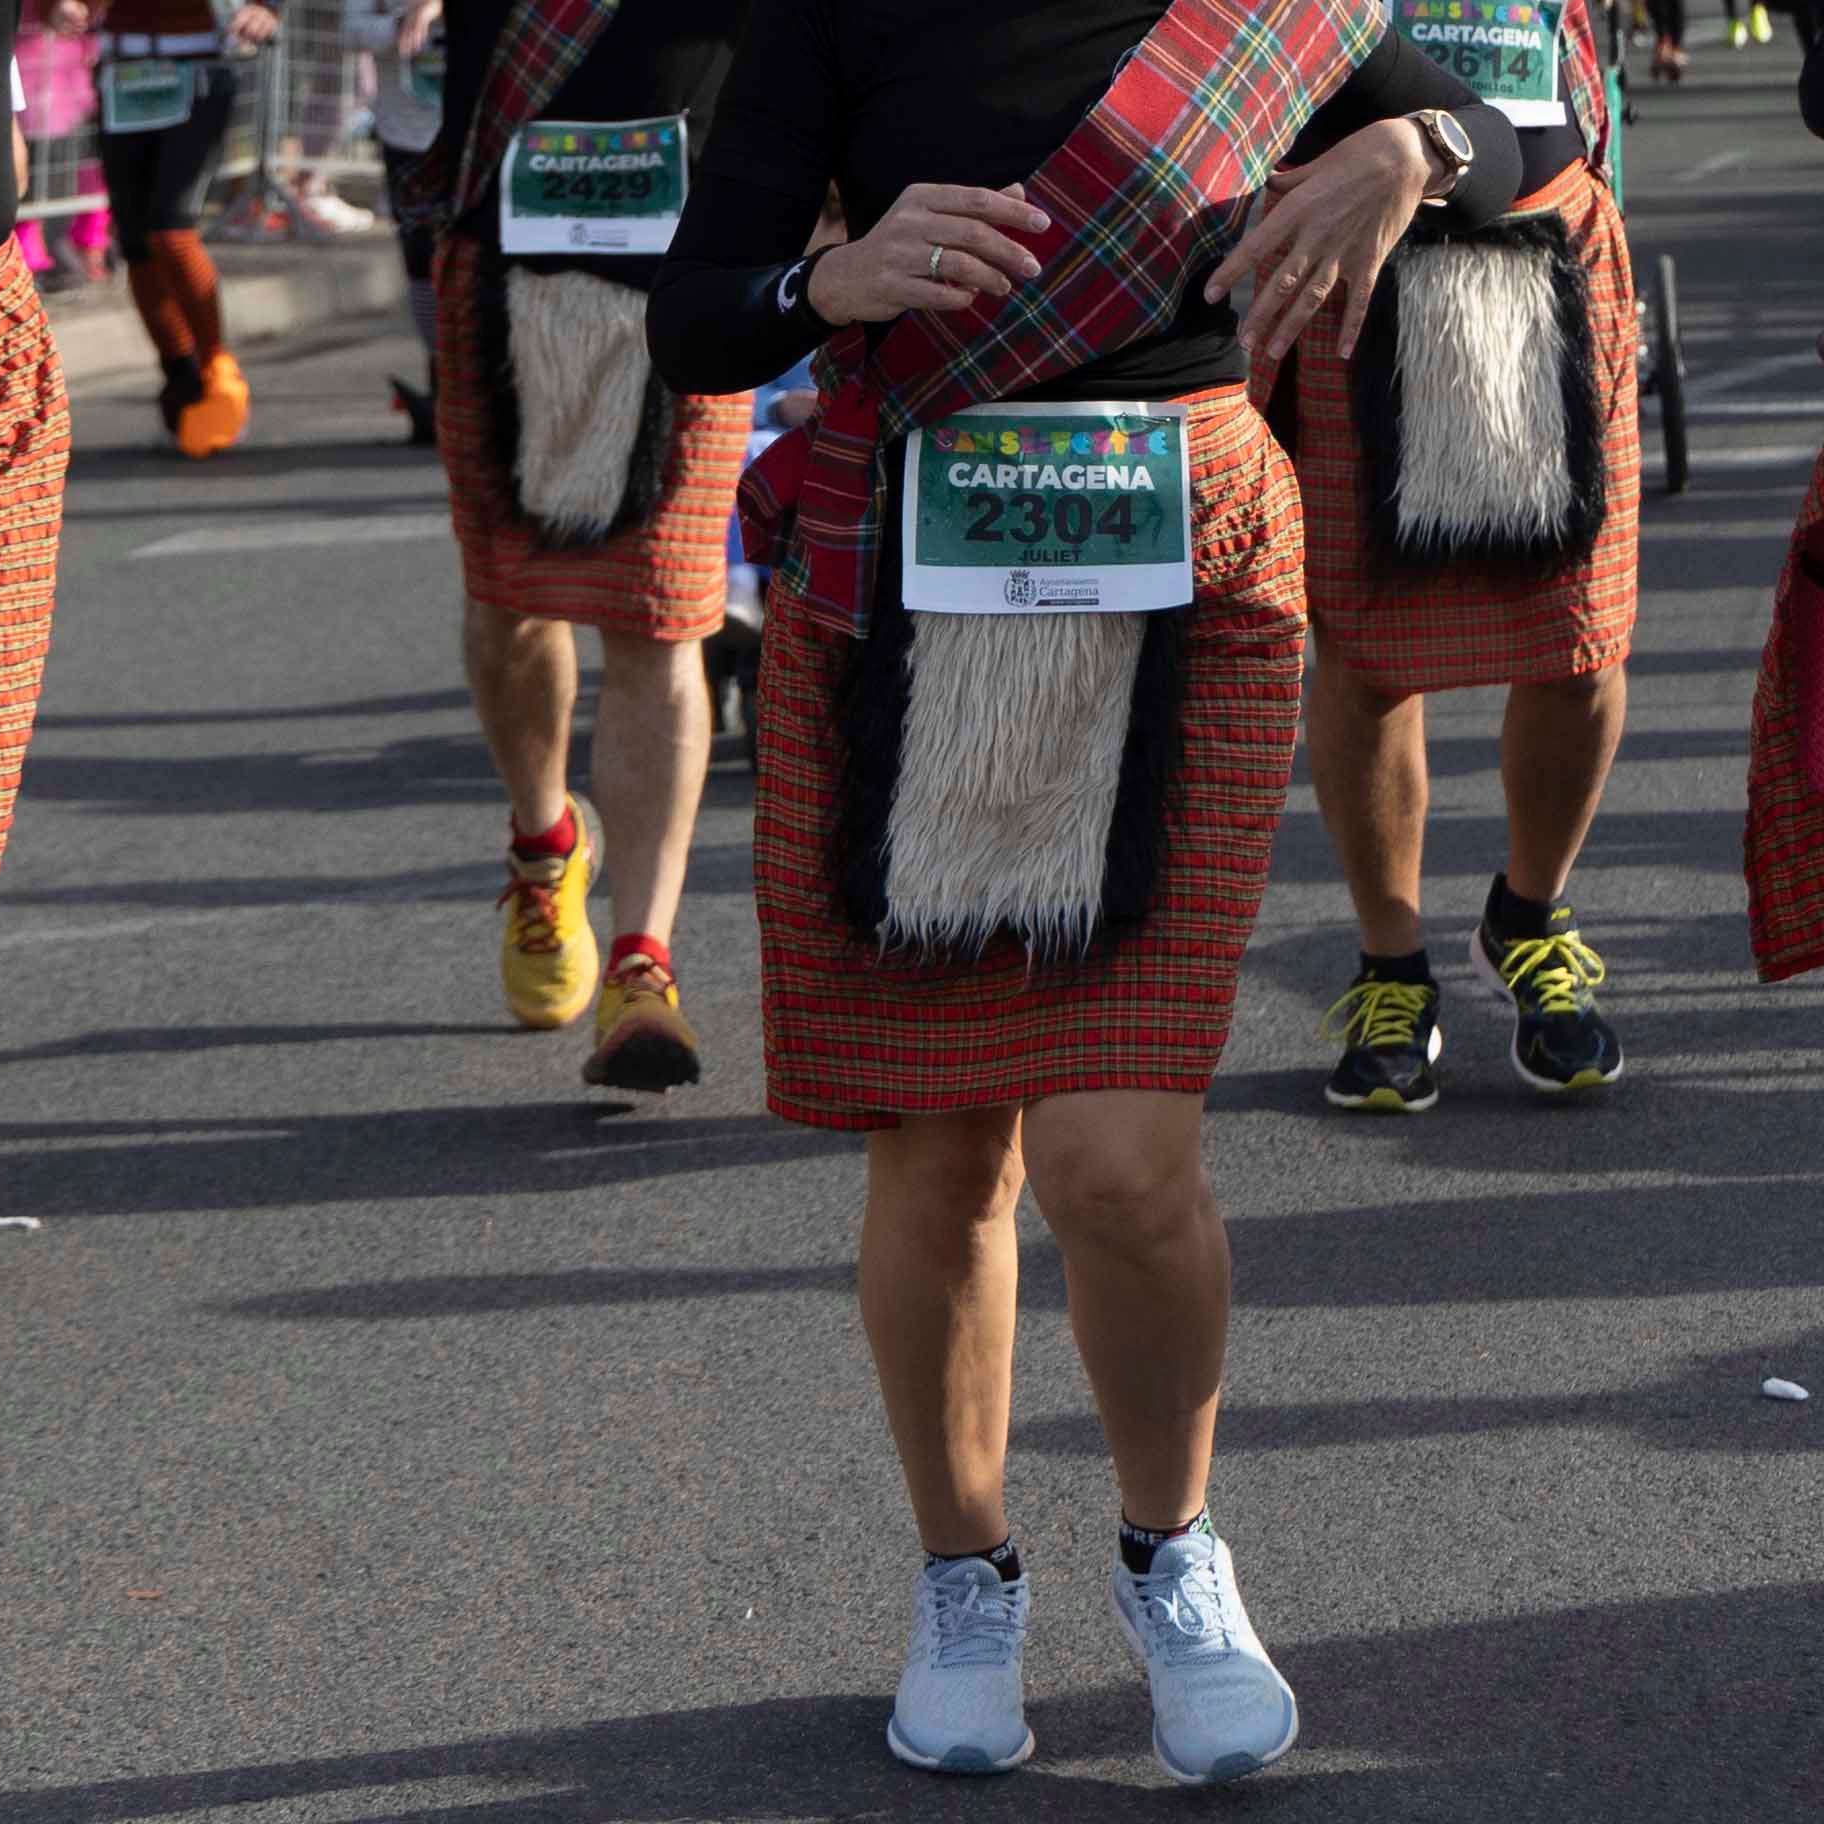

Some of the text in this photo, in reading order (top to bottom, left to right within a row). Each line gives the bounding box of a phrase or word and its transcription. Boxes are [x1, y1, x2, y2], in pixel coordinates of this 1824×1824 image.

[1411, 23, 1542, 50] CARTAGENA
[529, 152, 665, 172] CARTAGENA
[543, 171, 652, 201] 2429
[947, 462, 1156, 491] CARTAGENA
[964, 493, 1137, 545] 2304
[1018, 549, 1083, 563] JULIET
